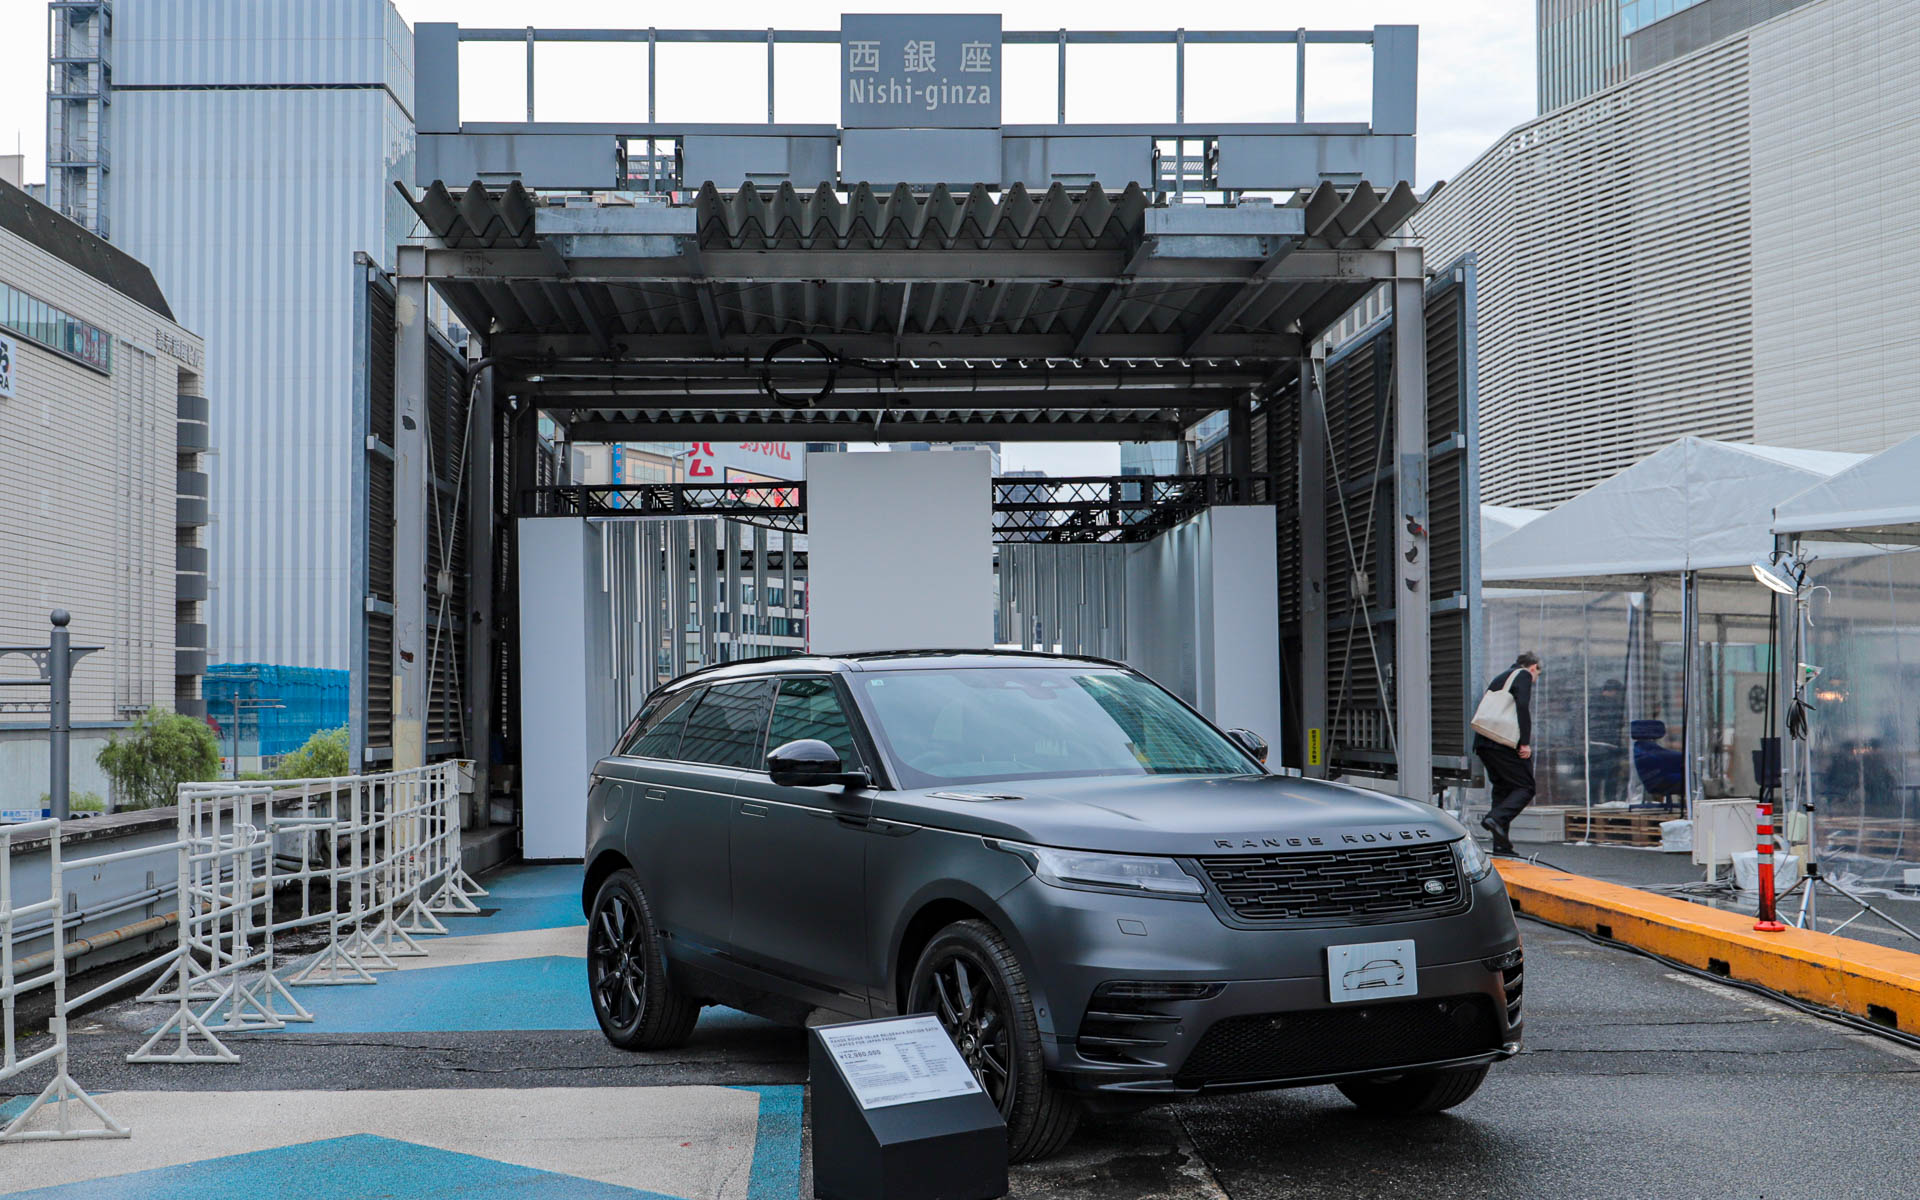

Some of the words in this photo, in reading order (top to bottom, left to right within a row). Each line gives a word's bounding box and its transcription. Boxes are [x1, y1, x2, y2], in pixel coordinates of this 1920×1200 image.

[848, 40, 992, 73] 西銀座
[849, 77, 991, 110] Nishi-ginza
[1213, 836, 1324, 849] RANGE
[1341, 829, 1432, 843] ROVER
